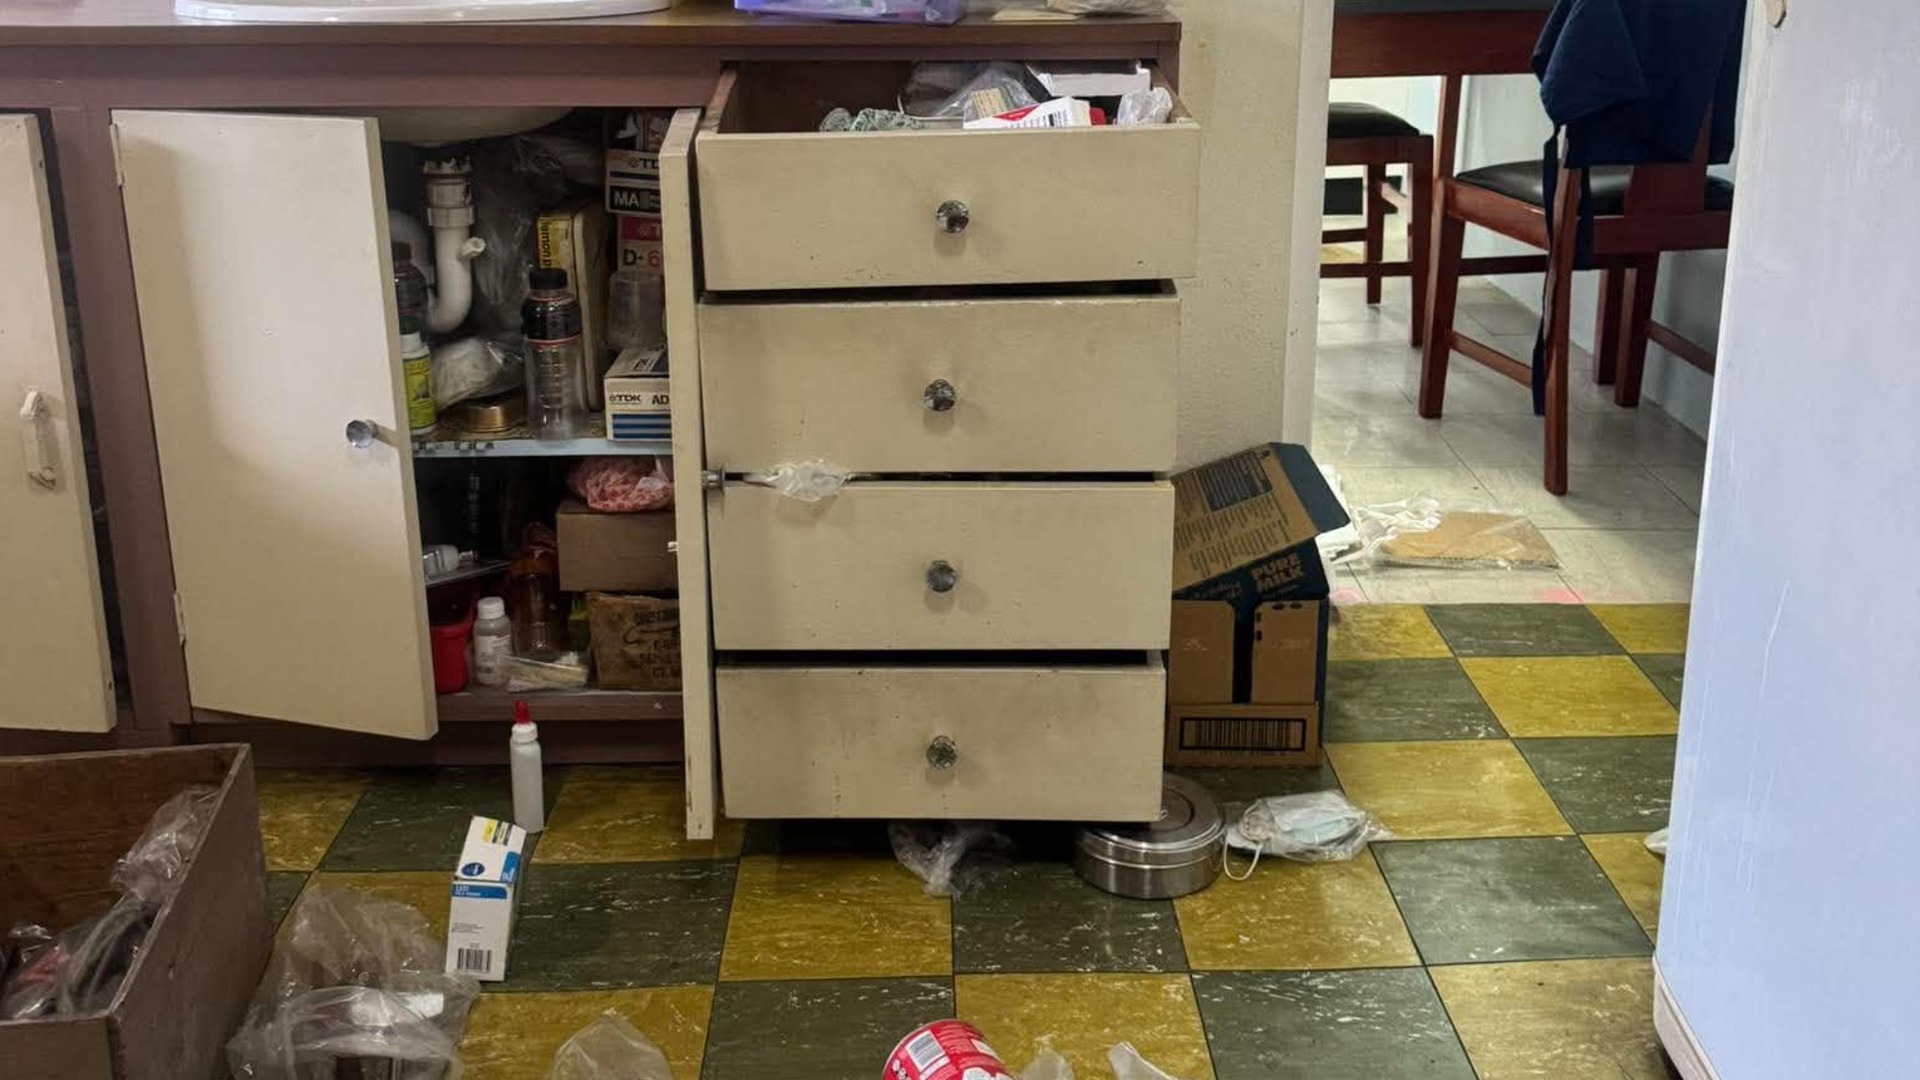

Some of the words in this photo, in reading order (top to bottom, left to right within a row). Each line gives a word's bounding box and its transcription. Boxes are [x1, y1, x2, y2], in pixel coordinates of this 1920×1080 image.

[614, 190, 640, 209] MA
[616, 394, 641, 402] TDK
[1252, 553, 1300, 581] PURE
[1256, 565, 1304, 595] MILK
